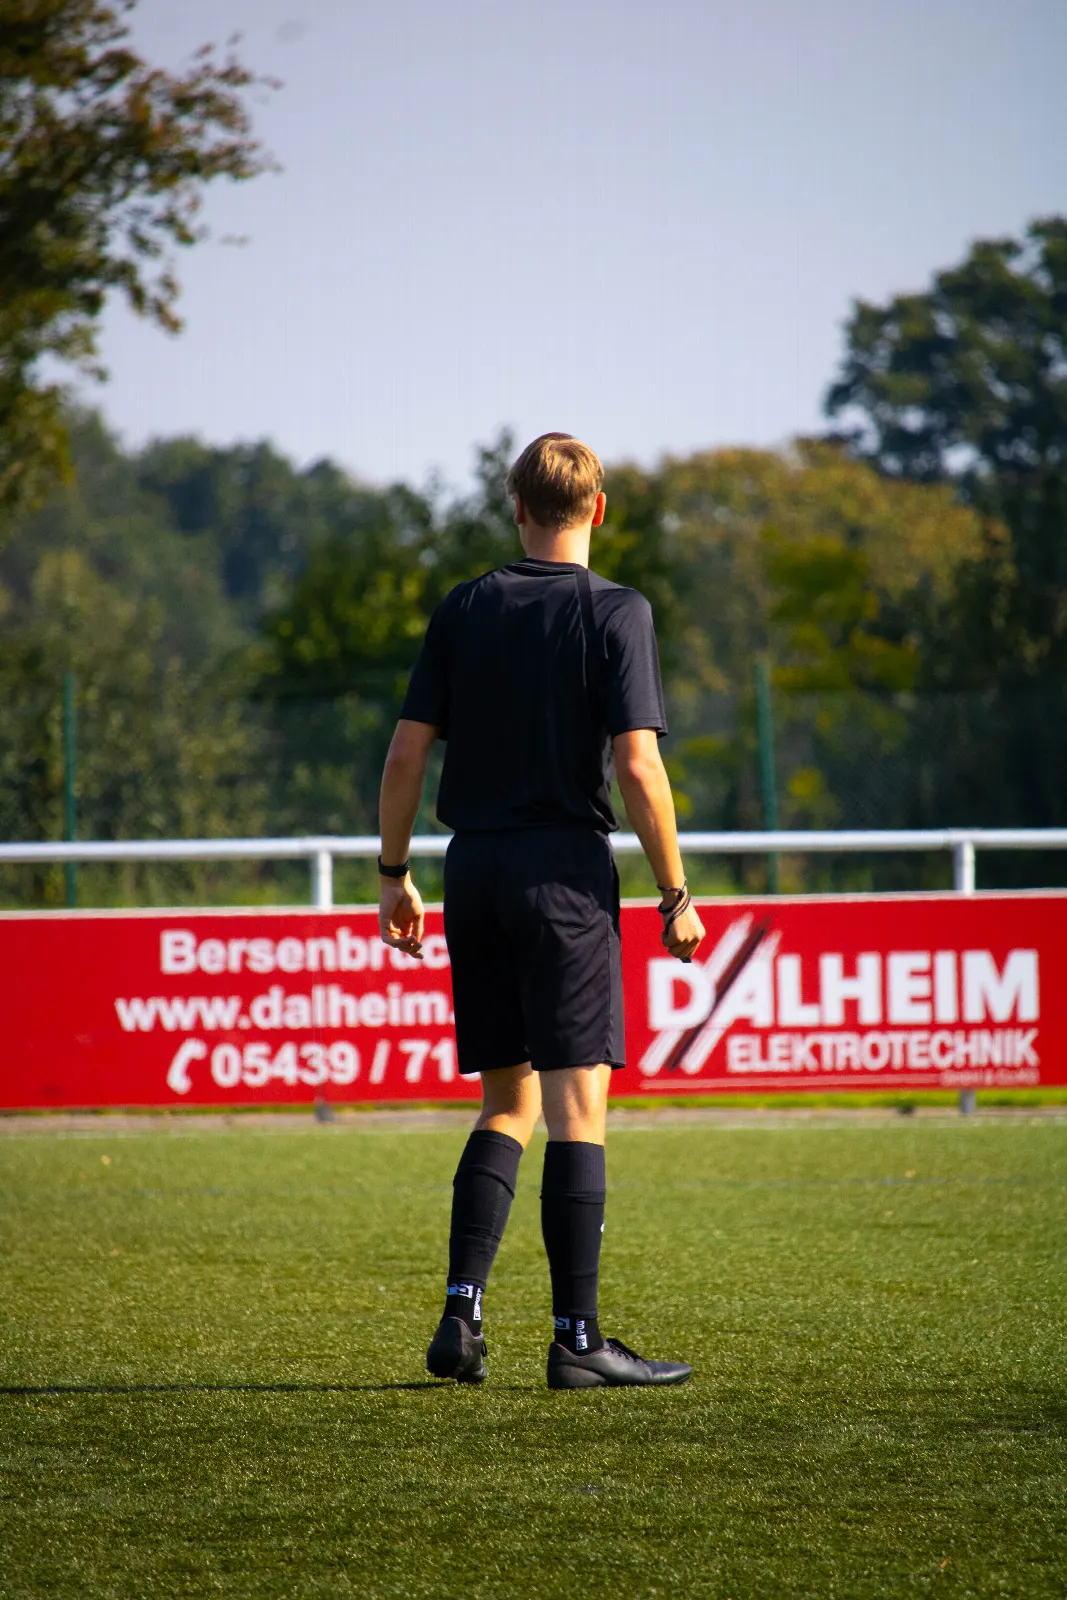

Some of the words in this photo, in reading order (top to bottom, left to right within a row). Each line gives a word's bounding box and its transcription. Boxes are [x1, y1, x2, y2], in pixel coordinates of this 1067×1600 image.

[647, 948, 1039, 1030] DALHEIM
[210, 1039, 360, 1088] 05439
[399, 1038, 482, 1084] 71
[726, 1028, 1039, 1073] ELEKTROTECHNIK
